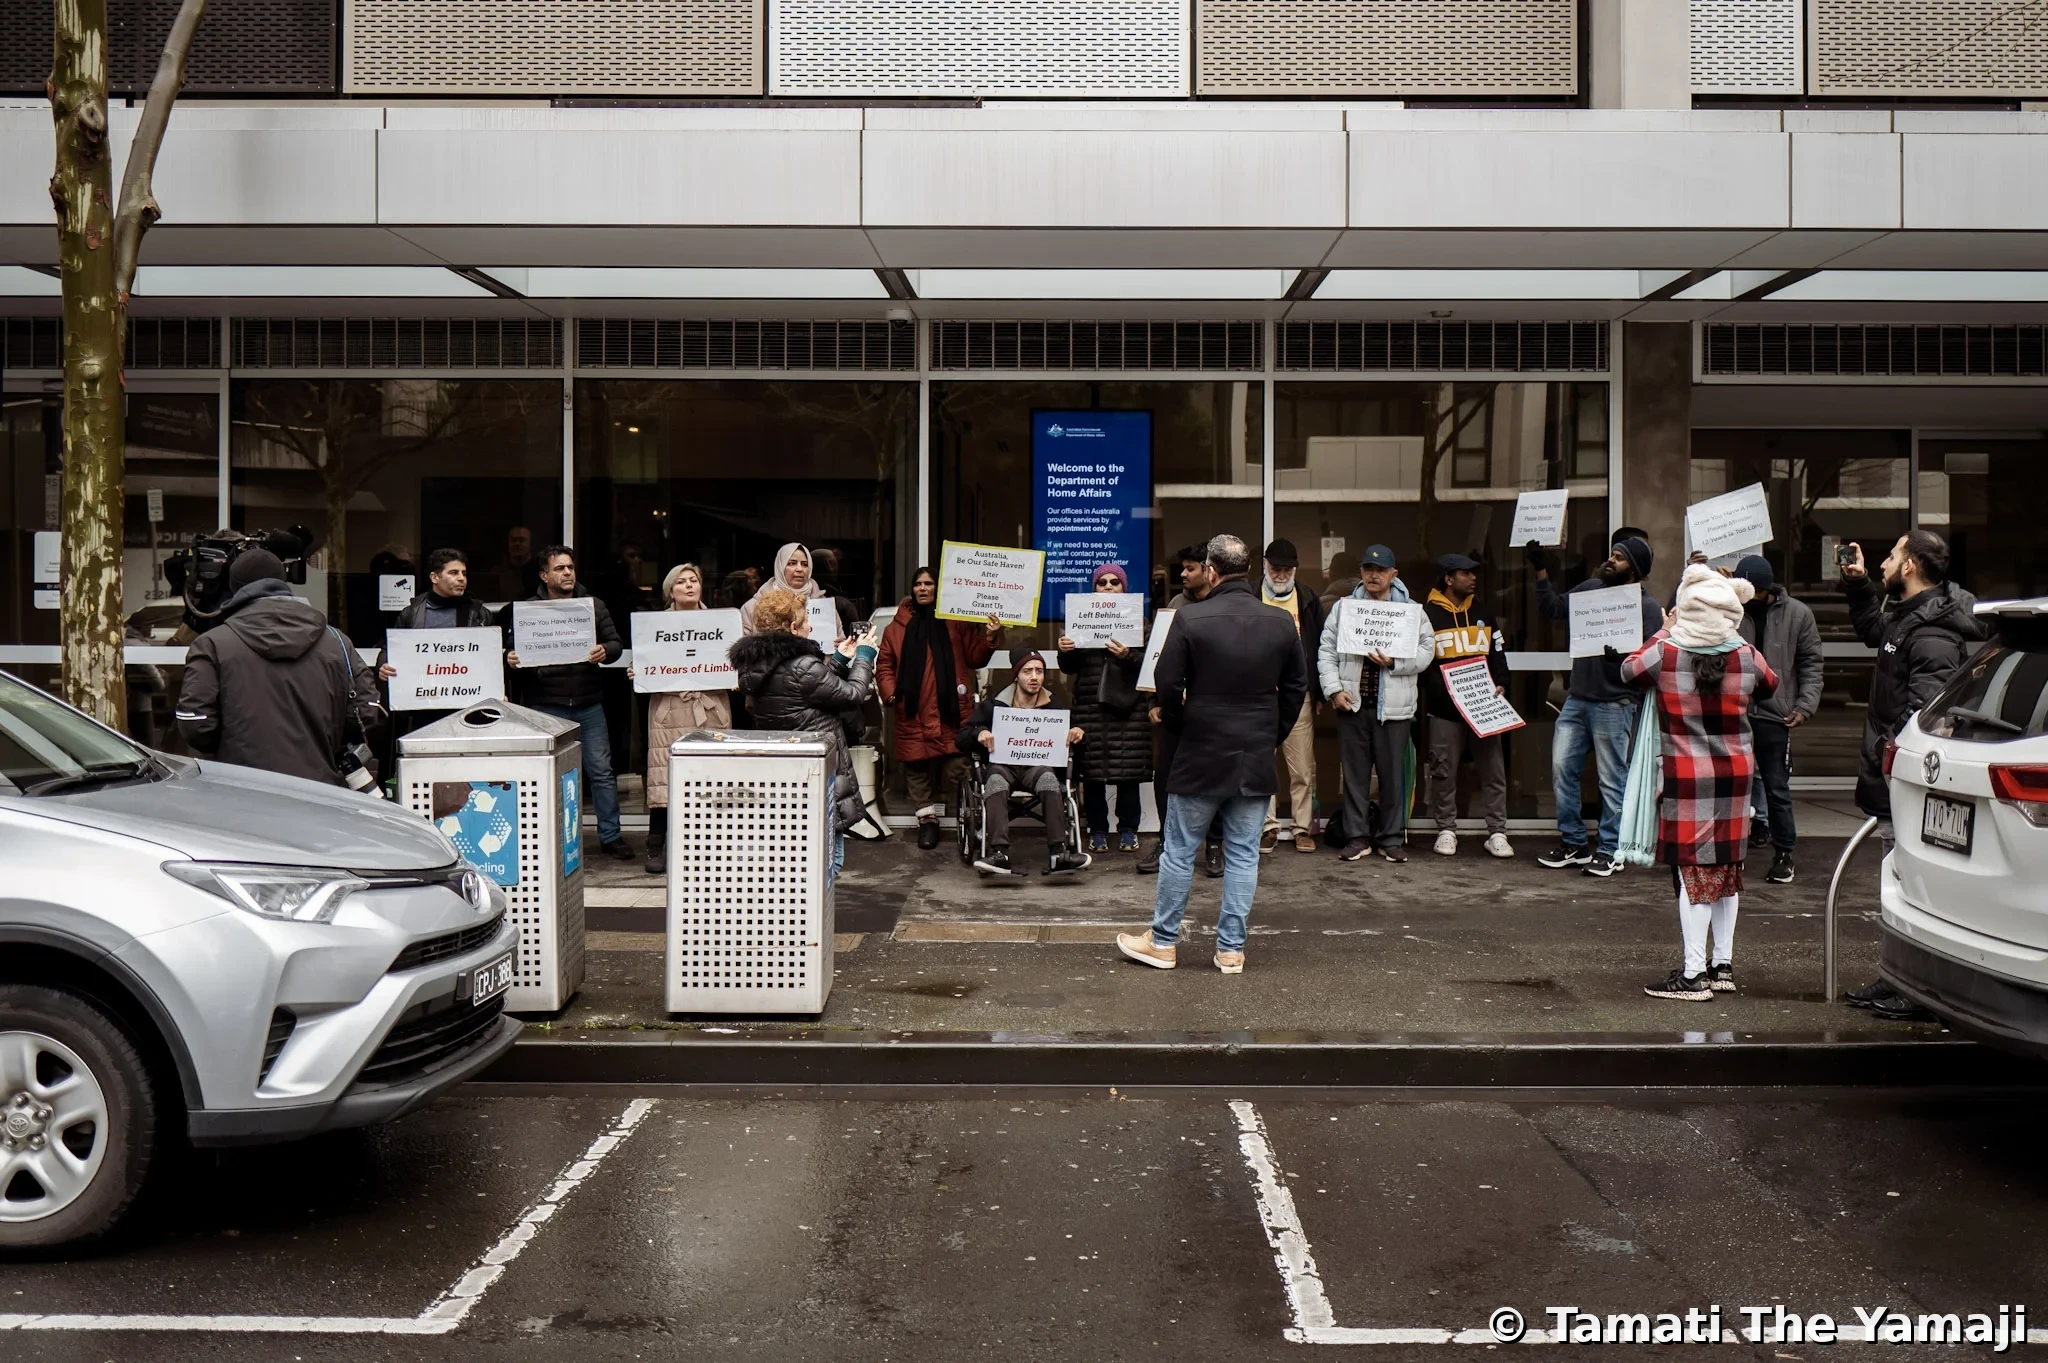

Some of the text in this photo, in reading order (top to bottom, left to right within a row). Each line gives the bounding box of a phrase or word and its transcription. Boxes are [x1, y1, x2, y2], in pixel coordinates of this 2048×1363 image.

[1047, 463, 1125, 473] Welcome to the
[1047, 475, 1119, 486] Department of
[1047, 488, 1112, 498] Home Affairs
[1047, 507, 1120, 515] Our offices in Australia
[1047, 516, 1071, 524] provide
[1101, 516, 1110, 525] by
[1047, 525, 1109, 533] appointment only.
[1104, 542, 1118, 550] you,
[974, 550, 1008, 560] Australia,
[1109, 550, 1117, 558] by
[967, 558, 981, 566] Our
[984, 560, 998, 568] Safe
[999, 561, 1025, 569] Haven!
[964, 578, 985, 587] Years
[998, 581, 1024, 591] Limbo
[976, 592, 999, 601] Please
[972, 601, 1003, 610] Grant Us
[1091, 601, 1116, 609] 10,000
[1622, 602, 1637, 610] Heart
[812, 606, 820, 615] In
[1357, 607, 1369, 615] We
[573, 616, 591, 624] Heart
[1364, 618, 1394, 628] Danger,
[1605, 617, 1627, 625] Minister
[1072, 622, 1112, 630] Permanent
[532, 629, 579, 638] Please Minister
[655, 628, 724, 642] FastTrack
[1094, 632, 1113, 640] Now!
[1355, 627, 1402, 638] We Deserve
[1620, 628, 1634, 636] Long
[415, 642, 479, 653] 12 Years In
[534, 642, 551, 650] Years
[1363, 638, 1393, 649] Safety!
[1435, 629, 1490, 657] FILA
[426, 663, 468, 675] Limbo
[644, 666, 656, 676] 12
[659, 665, 688, 675] Years
[691, 664, 702, 673] of
[1452, 672, 1487, 685] PERMANENT
[415, 685, 481, 697] End It Now!
[1456, 680, 1491, 693] VISAS NOW!
[1464, 688, 1490, 700] END THE
[1463, 695, 1491, 707] POVERTY
[1469, 700, 1503, 713] INSECURITY
[1480, 704, 1509, 717] BRIDGING
[1011, 715, 1031, 723] Years,
[1043, 716, 1063, 724] Future
[1475, 717, 1493, 725] VISAS
[1024, 726, 1040, 734] End
[1007, 737, 1054, 748] FastTrack
[1010, 750, 1050, 760] Injustice!
[479, 862, 505, 875] cling
